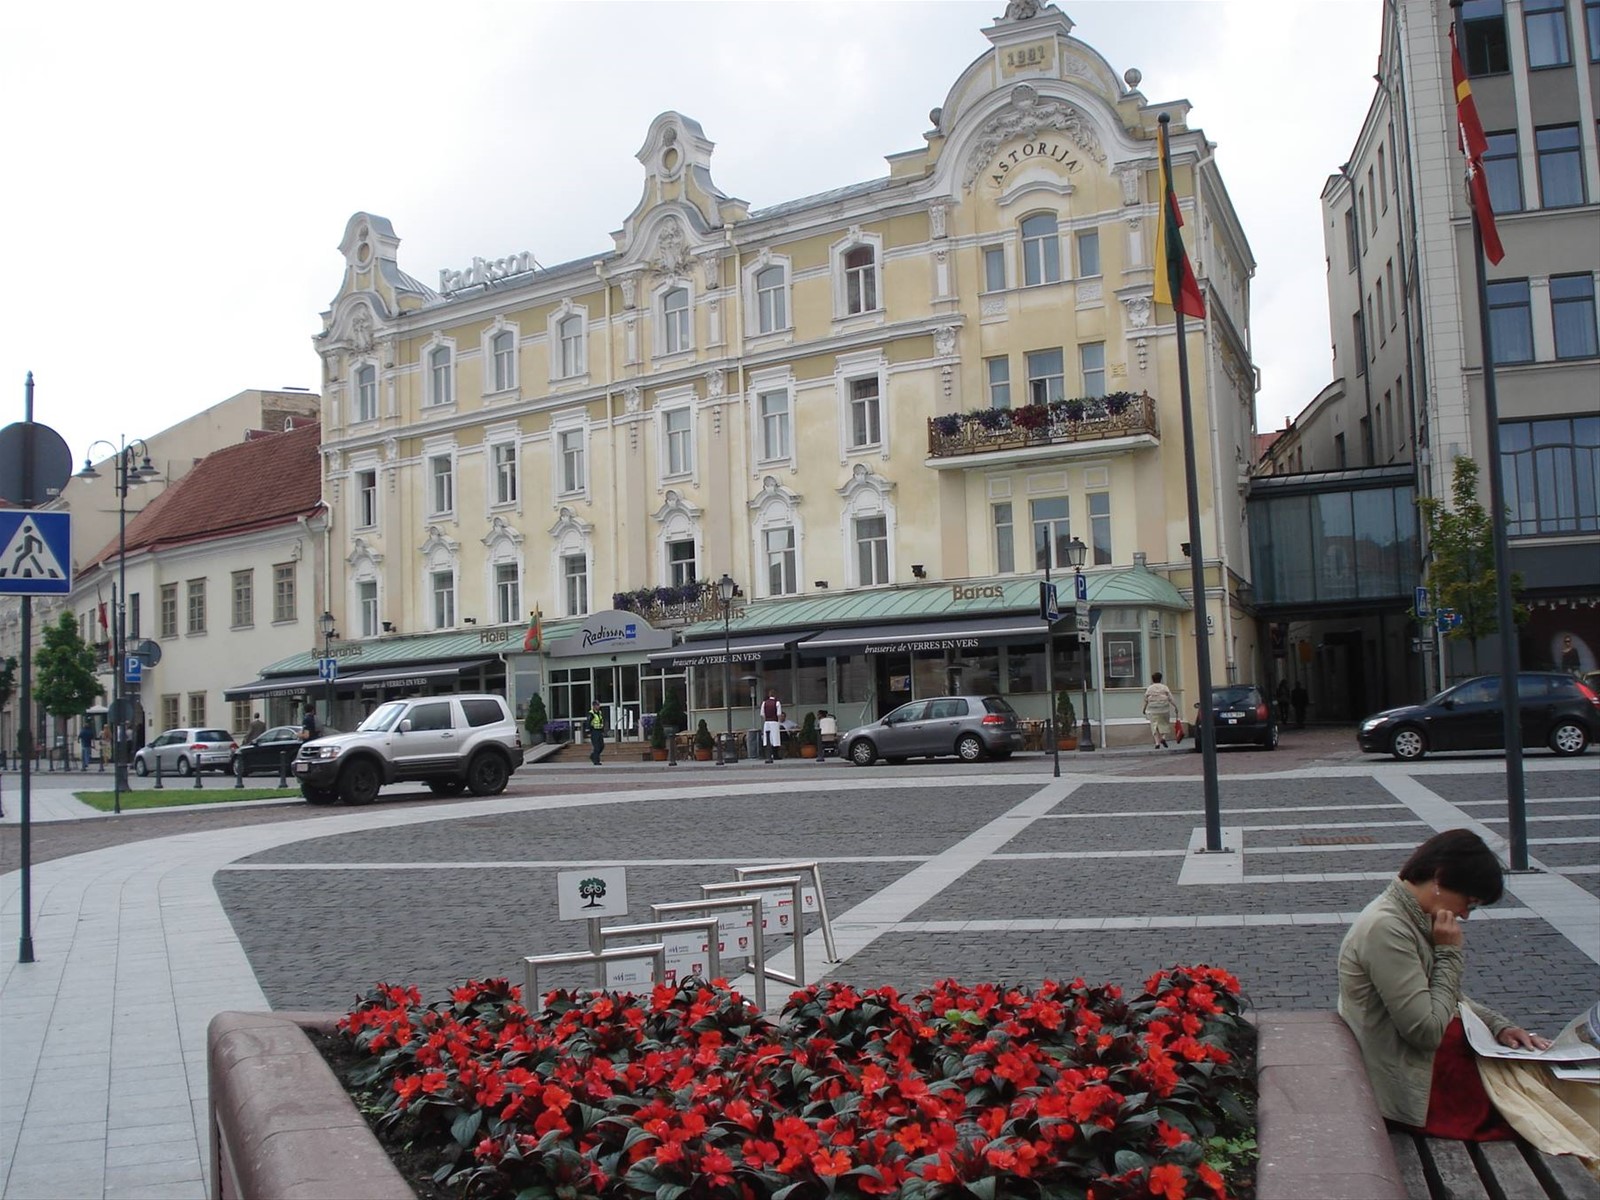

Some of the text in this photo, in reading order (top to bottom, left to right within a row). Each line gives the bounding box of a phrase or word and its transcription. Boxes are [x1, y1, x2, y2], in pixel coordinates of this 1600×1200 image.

[991, 142, 1078, 186] ASTORIJA
[952, 583, 1003, 600] Baras
[1077, 576, 1085, 598] P
[480, 627, 508, 643] Hotel
[582, 624, 625, 648] Radisson
[864, 638, 979, 654] brasserie de VERRES EN VERS
[731, 653, 742, 662] EN
[742, 652, 761, 661] VERS
[128, 658, 139, 673] P
